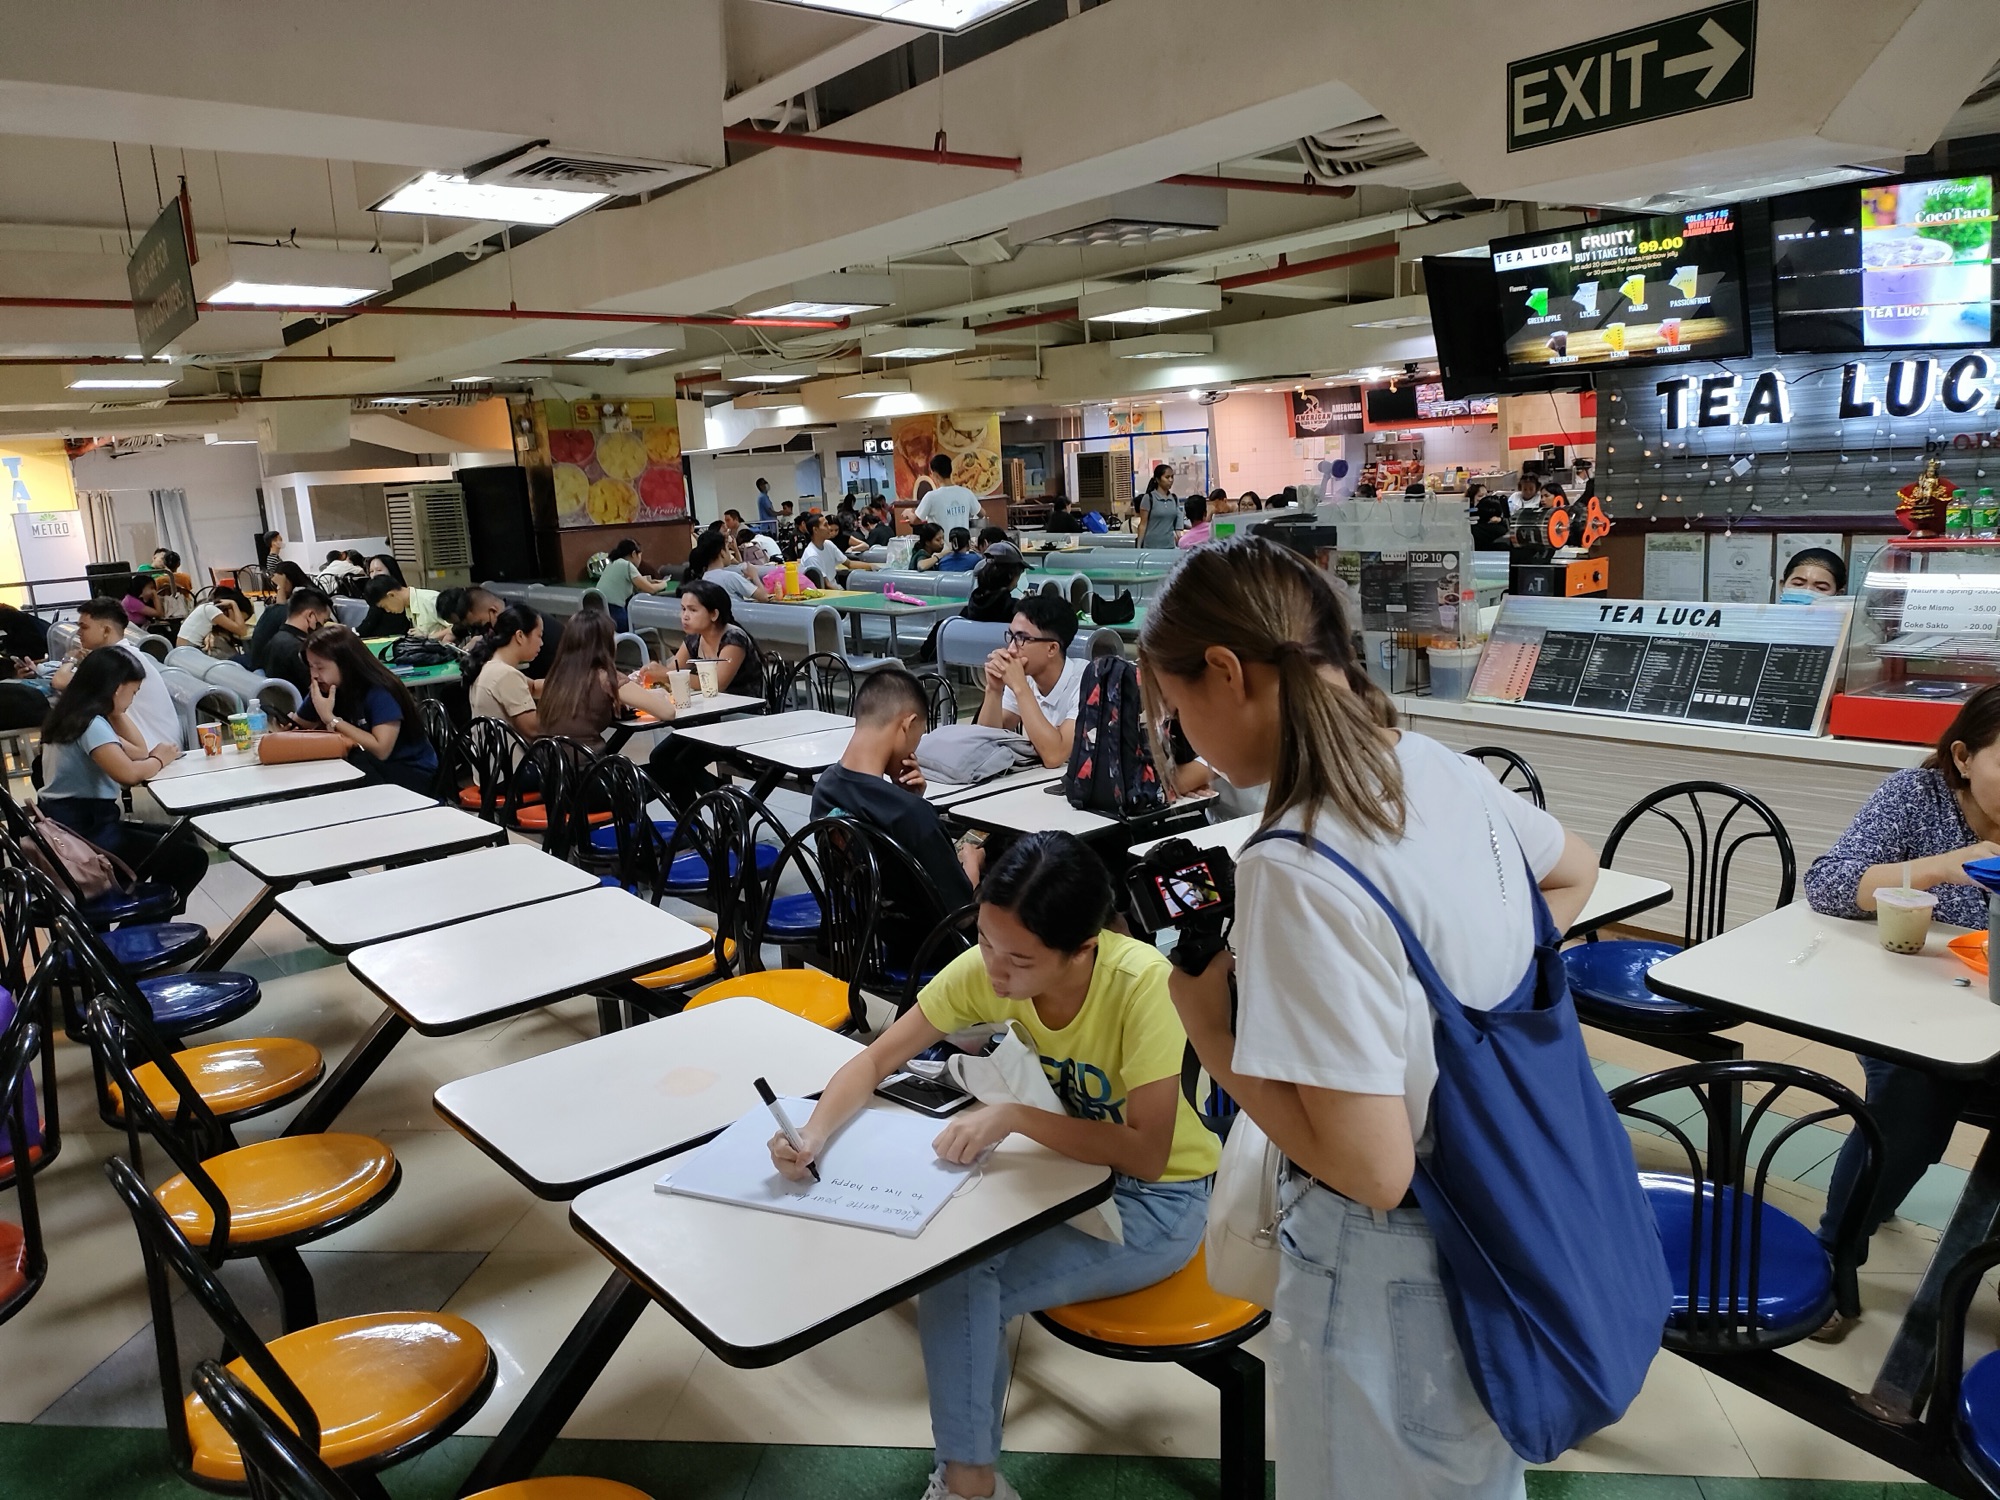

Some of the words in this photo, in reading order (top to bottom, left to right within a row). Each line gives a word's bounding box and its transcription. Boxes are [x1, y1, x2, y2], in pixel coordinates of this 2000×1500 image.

[1513, 39, 1659, 137] EXIT
[1914, 207, 1991, 224] CocoTaro
[1581, 229, 1635, 250] FRUITY
[1496, 251, 1523, 264] TEA
[1532, 244, 1569, 259] LUCA
[1574, 251, 1591, 263] BUY
[1598, 248, 1619, 261] TAKE
[1624, 246, 1637, 256] for
[1638, 236, 1684, 254] 99.00
[1579, 309, 1601, 319] LYCHEE
[1628, 303, 1649, 313] MANGO
[1869, 306, 1894, 319] TEA
[1897, 304, 1929, 318] LUCA
[1656, 371, 1786, 429] TEA
[1839, 354, 2000, 420] LUC
[1331, 402, 1362, 413] AMERICAN
[1295, 413, 1331, 421] AMERICAN
[1925, 436, 1949, 456] by
[31, 522, 70, 536] METRO
[1410, 552, 1429, 562] TOP
[1431, 552, 1442, 562] 10
[1928, 604, 1955, 612] Mismo
[1599, 605, 1644, 624] TEA
[1656, 607, 1722, 628] LUCA
[1903, 621, 1924, 629] Coke
[830, 1178, 864, 1192] happy
[812, 1194, 844, 1206] your
[884, 1188, 902, 1198] live
[911, 1193, 925, 1201] to
[846, 1201, 880, 1212] write
[882, 1206, 921, 1222] Please
